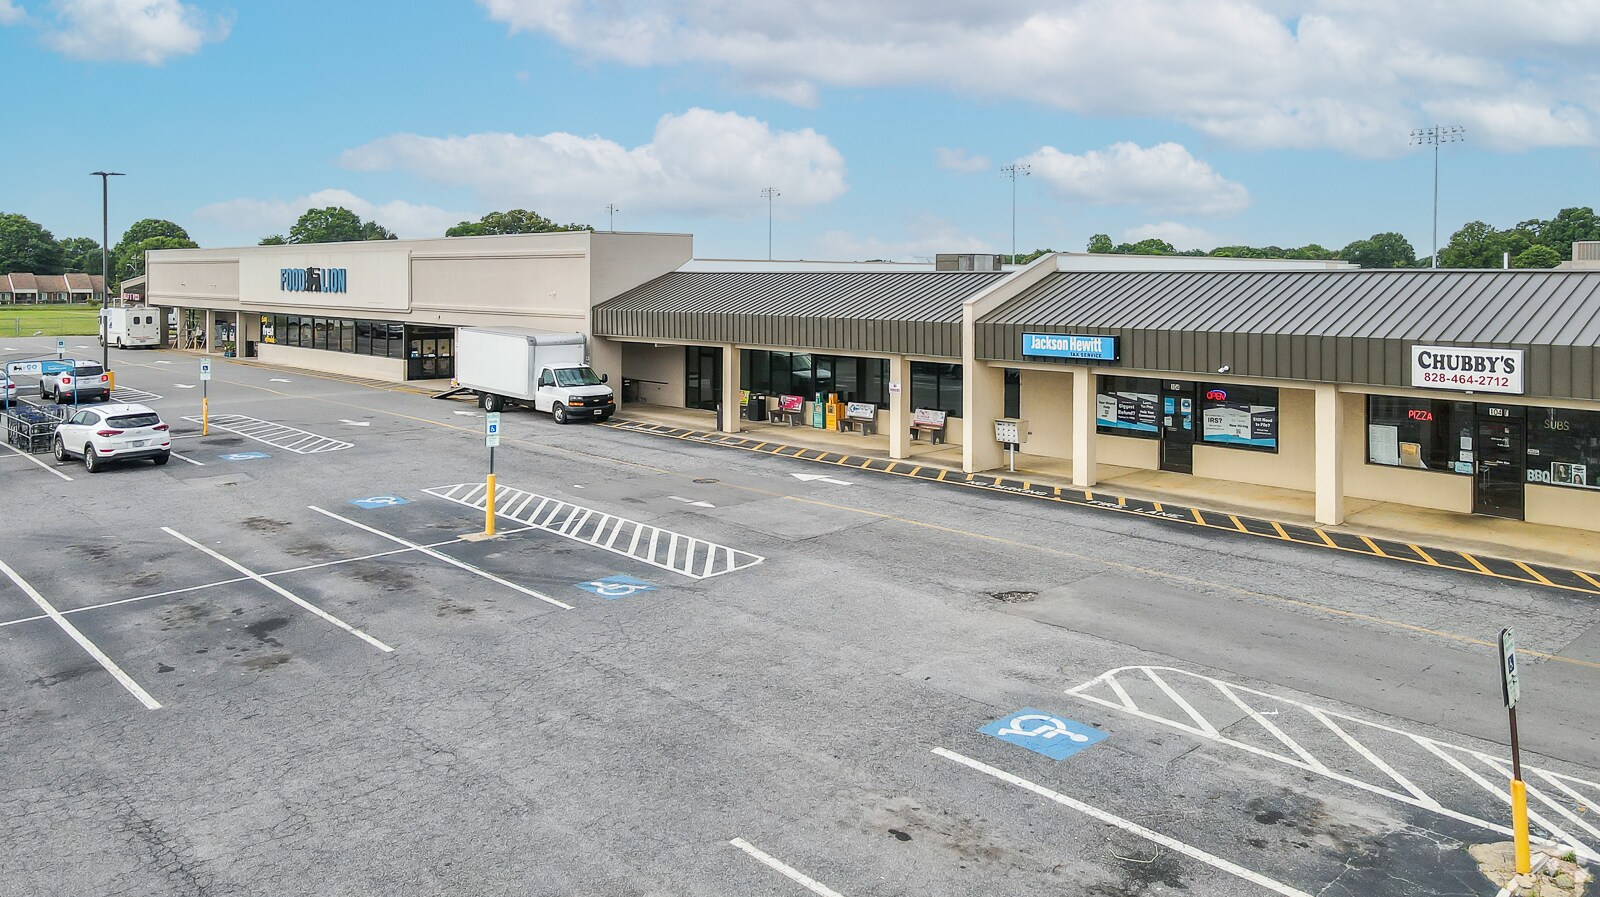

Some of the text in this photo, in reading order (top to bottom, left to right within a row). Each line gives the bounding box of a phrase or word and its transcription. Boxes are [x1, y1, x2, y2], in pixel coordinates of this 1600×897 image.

[281, 268, 346, 294] FOOD LION
[1031, 335, 1102, 353] Jackson Hewitt
[1418, 350, 1515, 374] CHUBBY'S
[1424, 373, 1509, 387] 828-464-2712
[1206, 391, 1226, 401] OPEN
[1408, 409, 1433, 421] PIZZA
[1544, 419, 1570, 431] SUBS
[1526, 469, 1551, 484] BBQ
[1133, 507, 1185, 519] LANE
